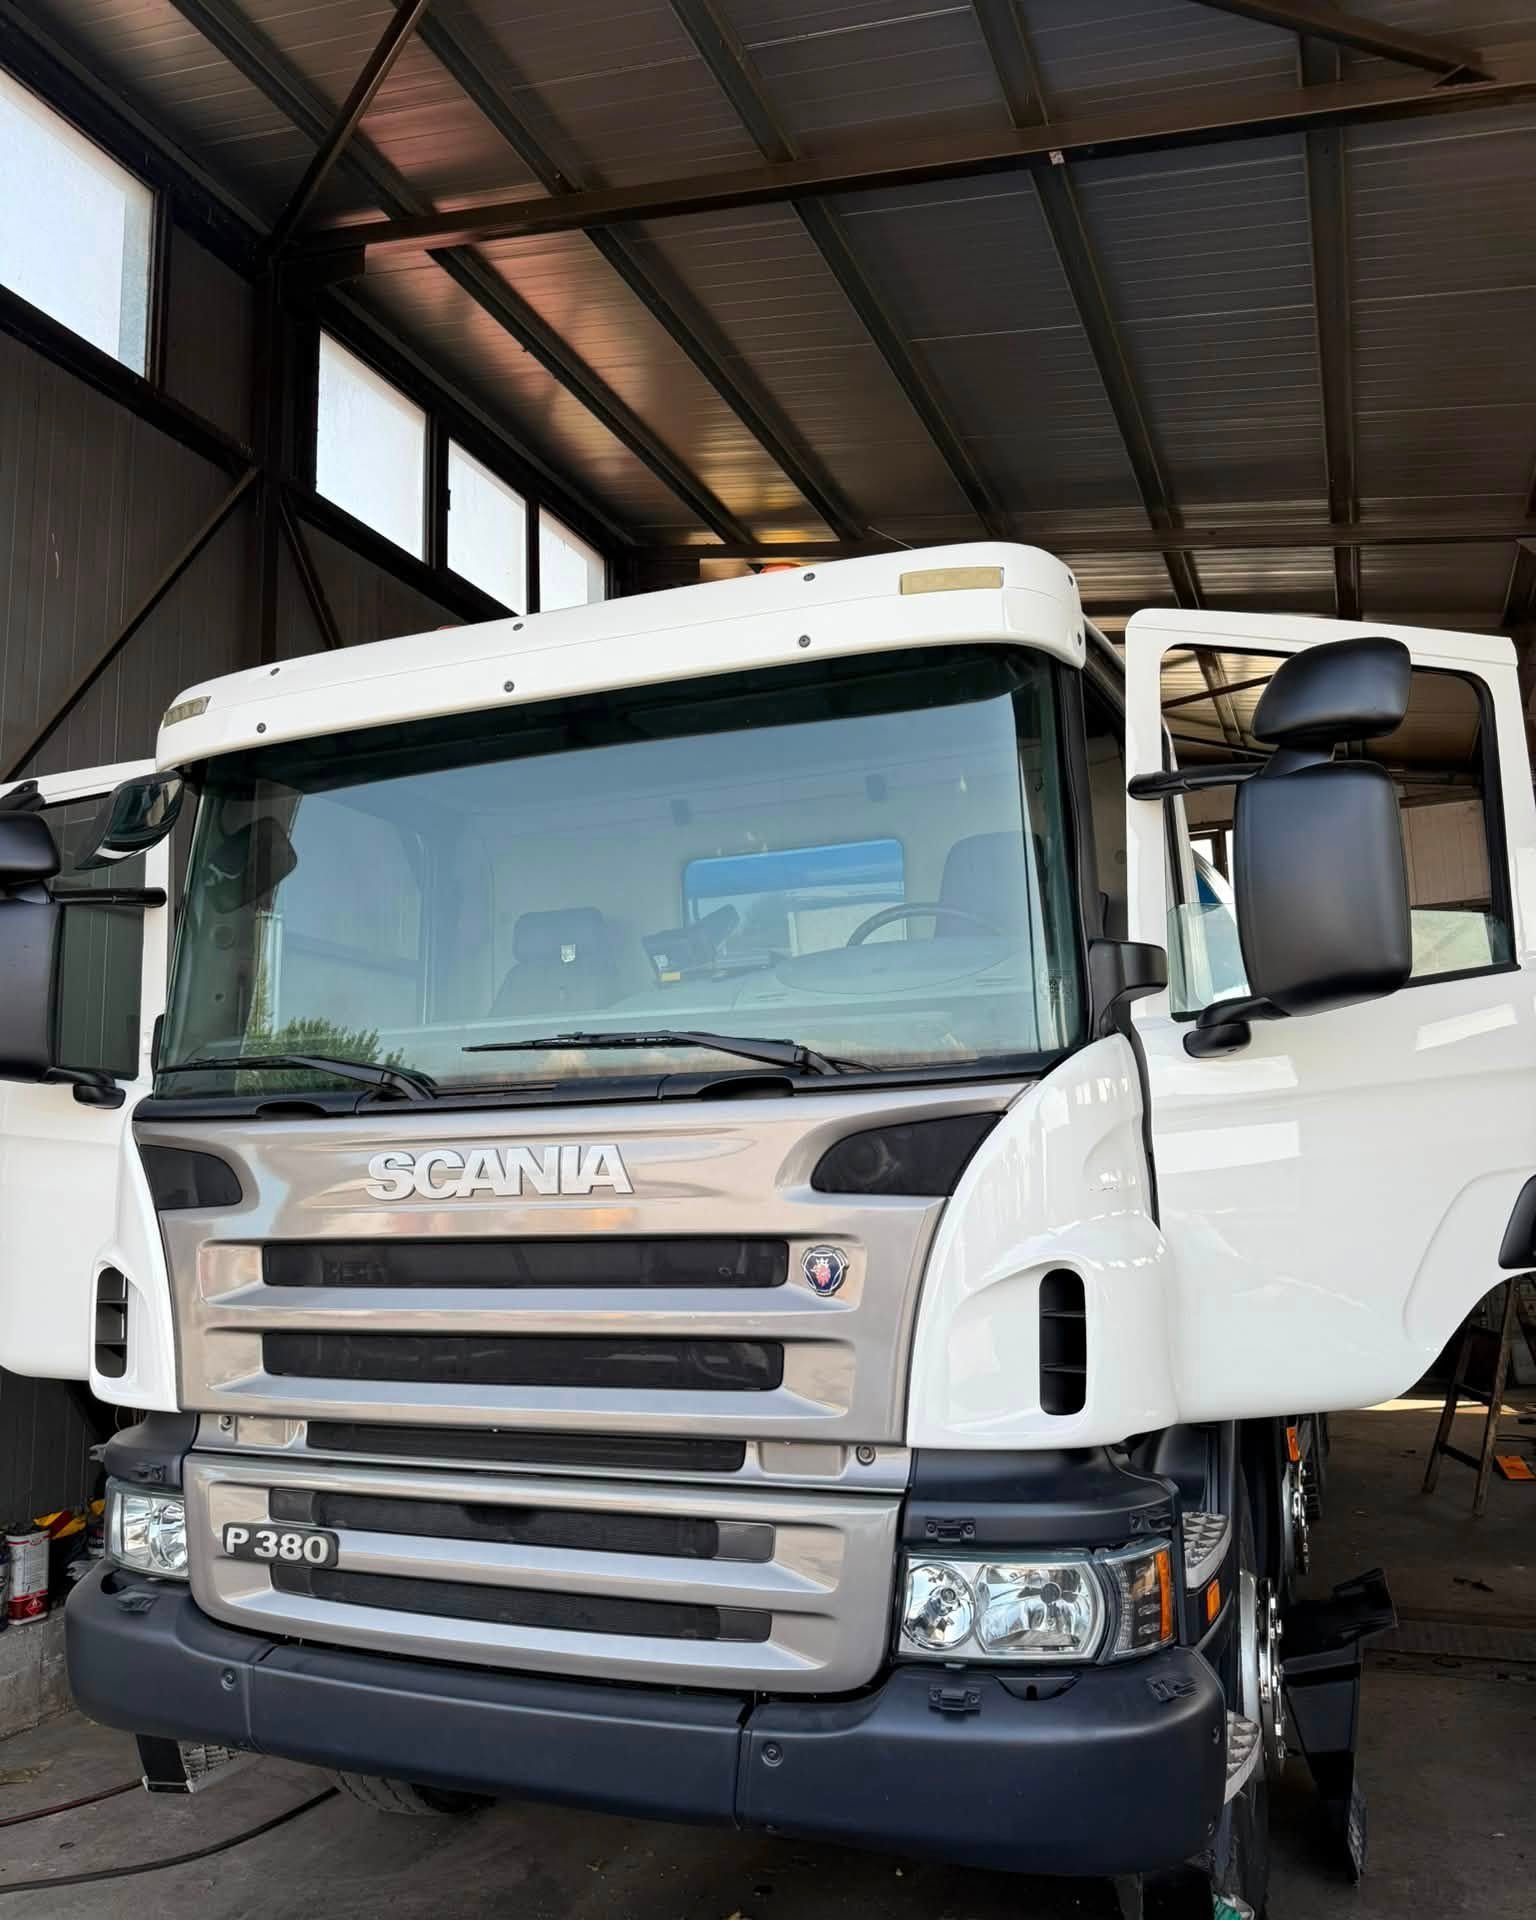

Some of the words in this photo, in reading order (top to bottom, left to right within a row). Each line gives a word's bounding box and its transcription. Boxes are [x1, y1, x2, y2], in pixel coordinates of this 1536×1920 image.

[366, 1144, 634, 1201] SCANIA
[226, 1527, 249, 1553] P
[254, 1530, 329, 1564] 380
